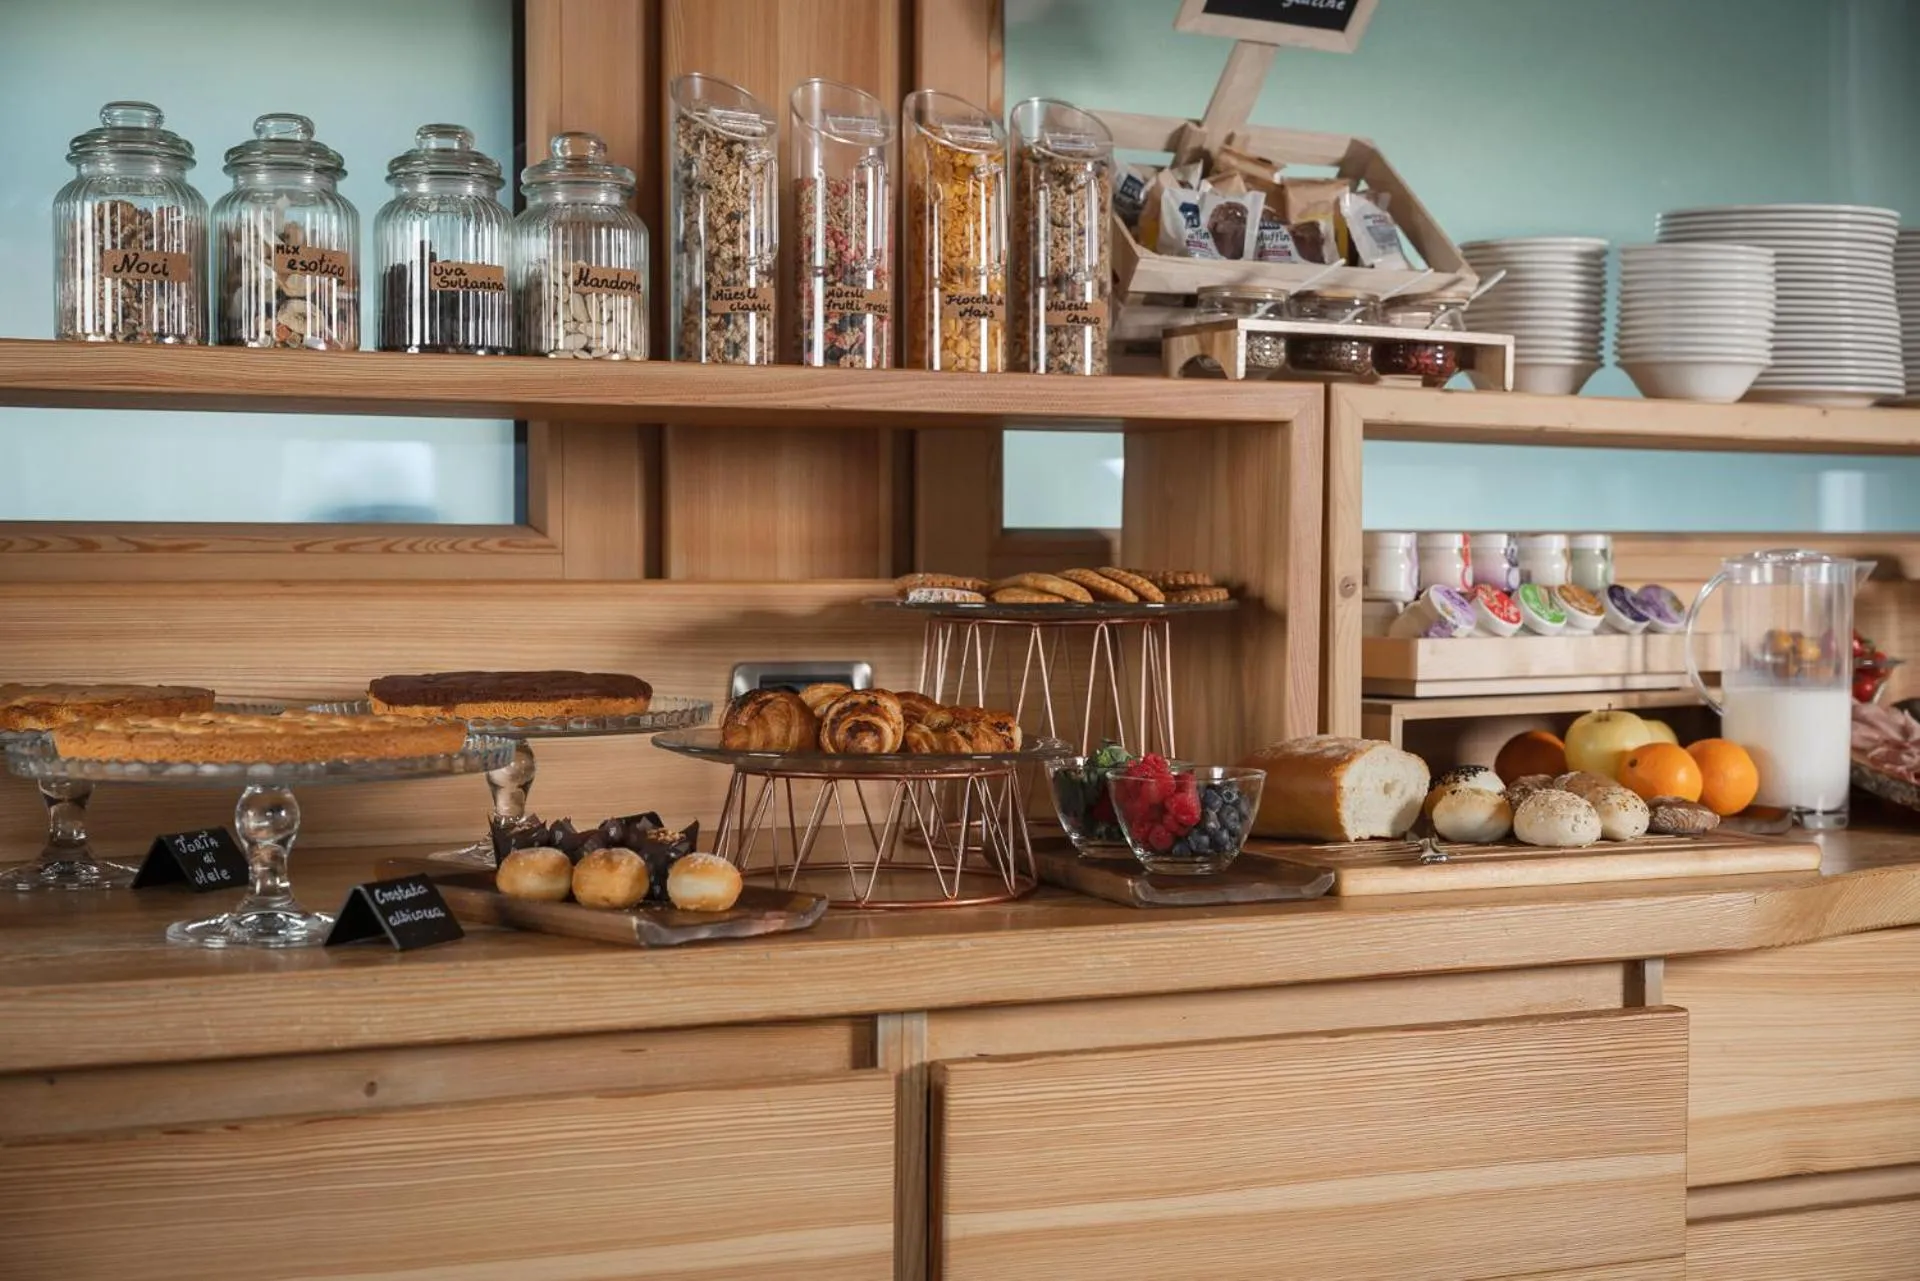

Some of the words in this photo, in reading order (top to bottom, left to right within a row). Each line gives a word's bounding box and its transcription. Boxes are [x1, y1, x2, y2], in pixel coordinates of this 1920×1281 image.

[113, 252, 170, 276] Noci
[287, 253, 345, 277] esotico
[433, 264, 466, 276] Uva
[437, 275, 505, 291] Sultanina
[574, 267, 641, 293] Mandorle
[959, 306, 995, 318] Mais
[195, 868, 231, 885] Mele
[374, 883, 429, 904] Crostata
